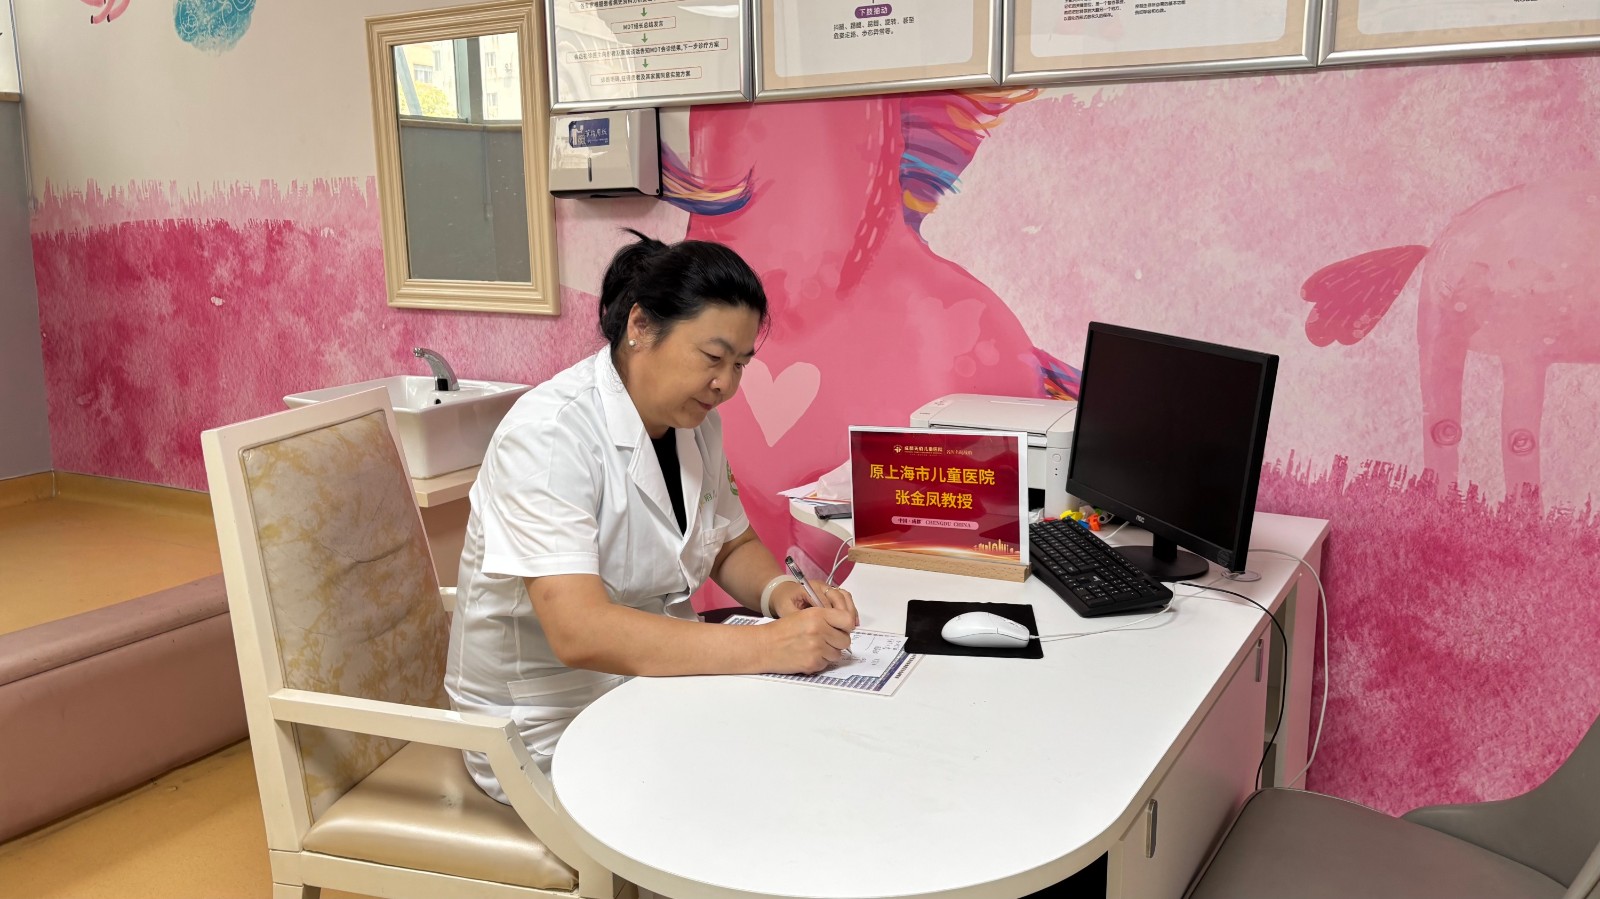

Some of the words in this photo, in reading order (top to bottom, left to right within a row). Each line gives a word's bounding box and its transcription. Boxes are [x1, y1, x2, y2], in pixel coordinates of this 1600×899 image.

[859, 6, 888, 16] 下肢抽动
[869, 464, 995, 485] 原上海市儿童医院
[895, 489, 973, 510] 张金凤教授
[925, 519, 952, 527] CHENGDU
